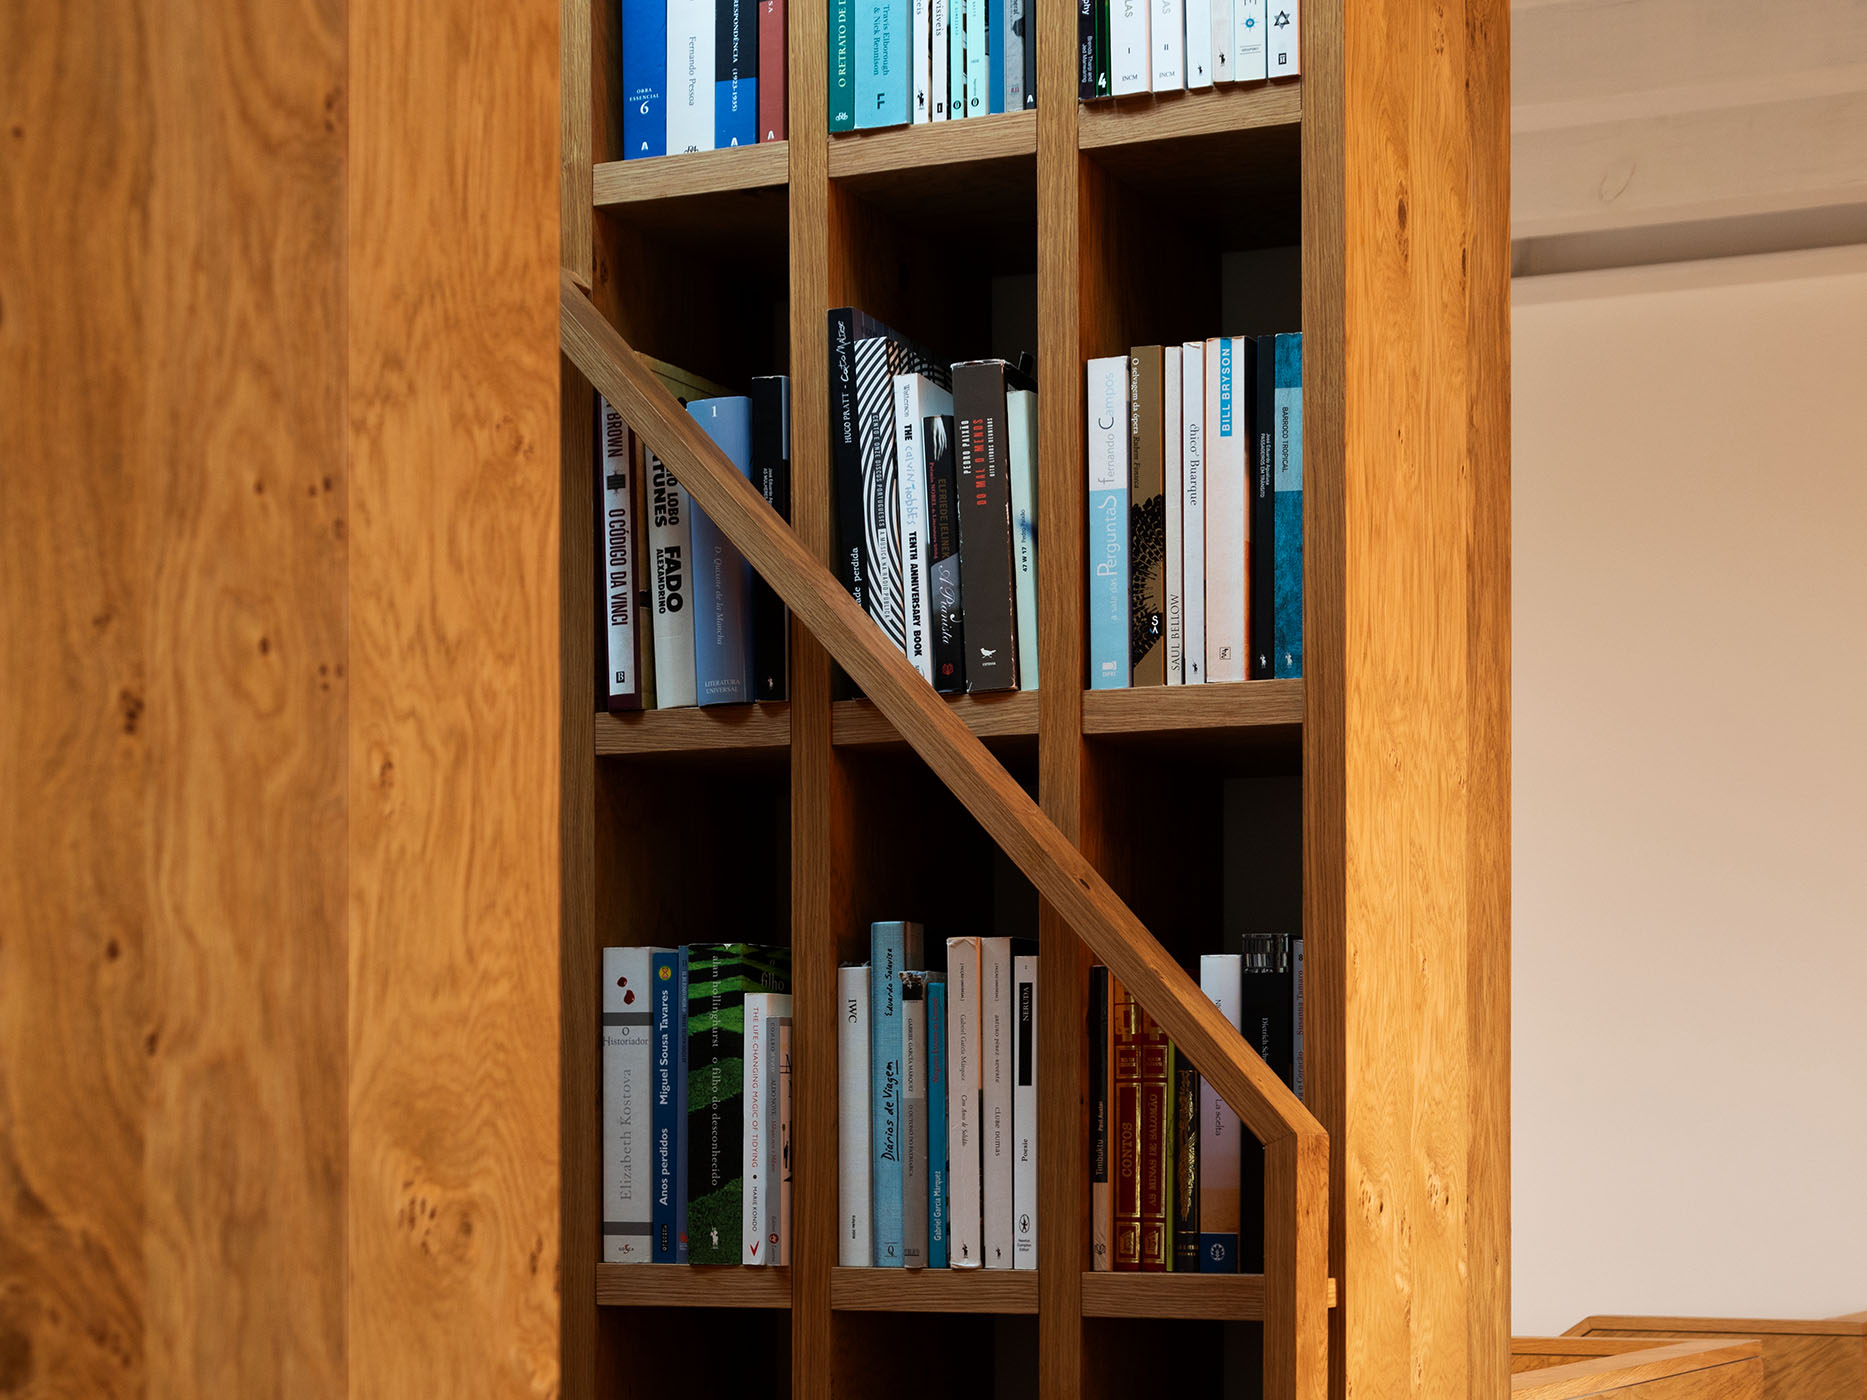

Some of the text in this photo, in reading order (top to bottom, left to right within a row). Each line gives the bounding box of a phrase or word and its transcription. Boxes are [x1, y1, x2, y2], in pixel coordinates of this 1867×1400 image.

[838, 8, 846, 88] O RETRATO DE
[882, 32, 890, 76] Elborough
[689, 36, 697, 106] Fernando Pessoa
[1098, 72, 1106, 88] 4
[629, 94, 660, 102] ESSENCIAL
[640, 100, 649, 114] 6
[877, 92, 885, 110] LL
[1131, 367, 1140, 400] selvagem
[1222, 348, 1230, 432] BILL BRYSON
[712, 406, 718, 418] 1
[842, 392, 852, 444] HUGO PRATT
[1098, 373, 1116, 430] Campos
[1133, 402, 1140, 412] da
[904, 424, 912, 440] THE
[972, 419, 984, 452] MENOS
[1132, 413, 1140, 434] ópera
[960, 420, 971, 474] PEDRO PAIXÃO
[976, 468, 986, 488] MAL
[1188, 460, 1200, 506] Buarque
[667, 492, 680, 526] LOBO
[876, 484, 885, 527] PORTUGUESES
[976, 494, 987, 506] DO
[607, 413, 629, 626] BROWN O CÓDIGO DA VINCI
[938, 479, 950, 558] ELFRIEDE JELINEK
[909, 532, 918, 560] TENTH
[656, 549, 666, 614] ALEXANDRINO
[664, 546, 683, 612] FADO
[850, 547, 862, 582] perdida
[910, 564, 921, 626] ANNIVERSARY
[940, 586, 955, 644] Pianista
[1170, 594, 1180, 670] SAUL BELLOW
[914, 630, 923, 657] BOOK
[712, 955, 721, 978] alan
[711, 981, 722, 1048] hollinghurst
[848, 1000, 857, 1024] IWC
[884, 984, 893, 1016] Eduardo
[622, 1027, 630, 1036] O
[660, 990, 670, 1105] Miguel Sousa Tavares
[712, 1067, 722, 1092] filho
[712, 1096, 721, 1110] do
[881, 1062, 898, 1162] Diários de Viagem
[620, 1070, 632, 1200] Elizabeth Kostova
[752, 1120, 758, 1130] OF
[1216, 1112, 1224, 1136] scelta
[660, 1128, 670, 1206] Anos perdidos
[712, 1113, 721, 1186] desconhecido
[1096, 1140, 1104, 1175] Timbuktu
[1122, 1122, 1132, 1177] CONTOS
